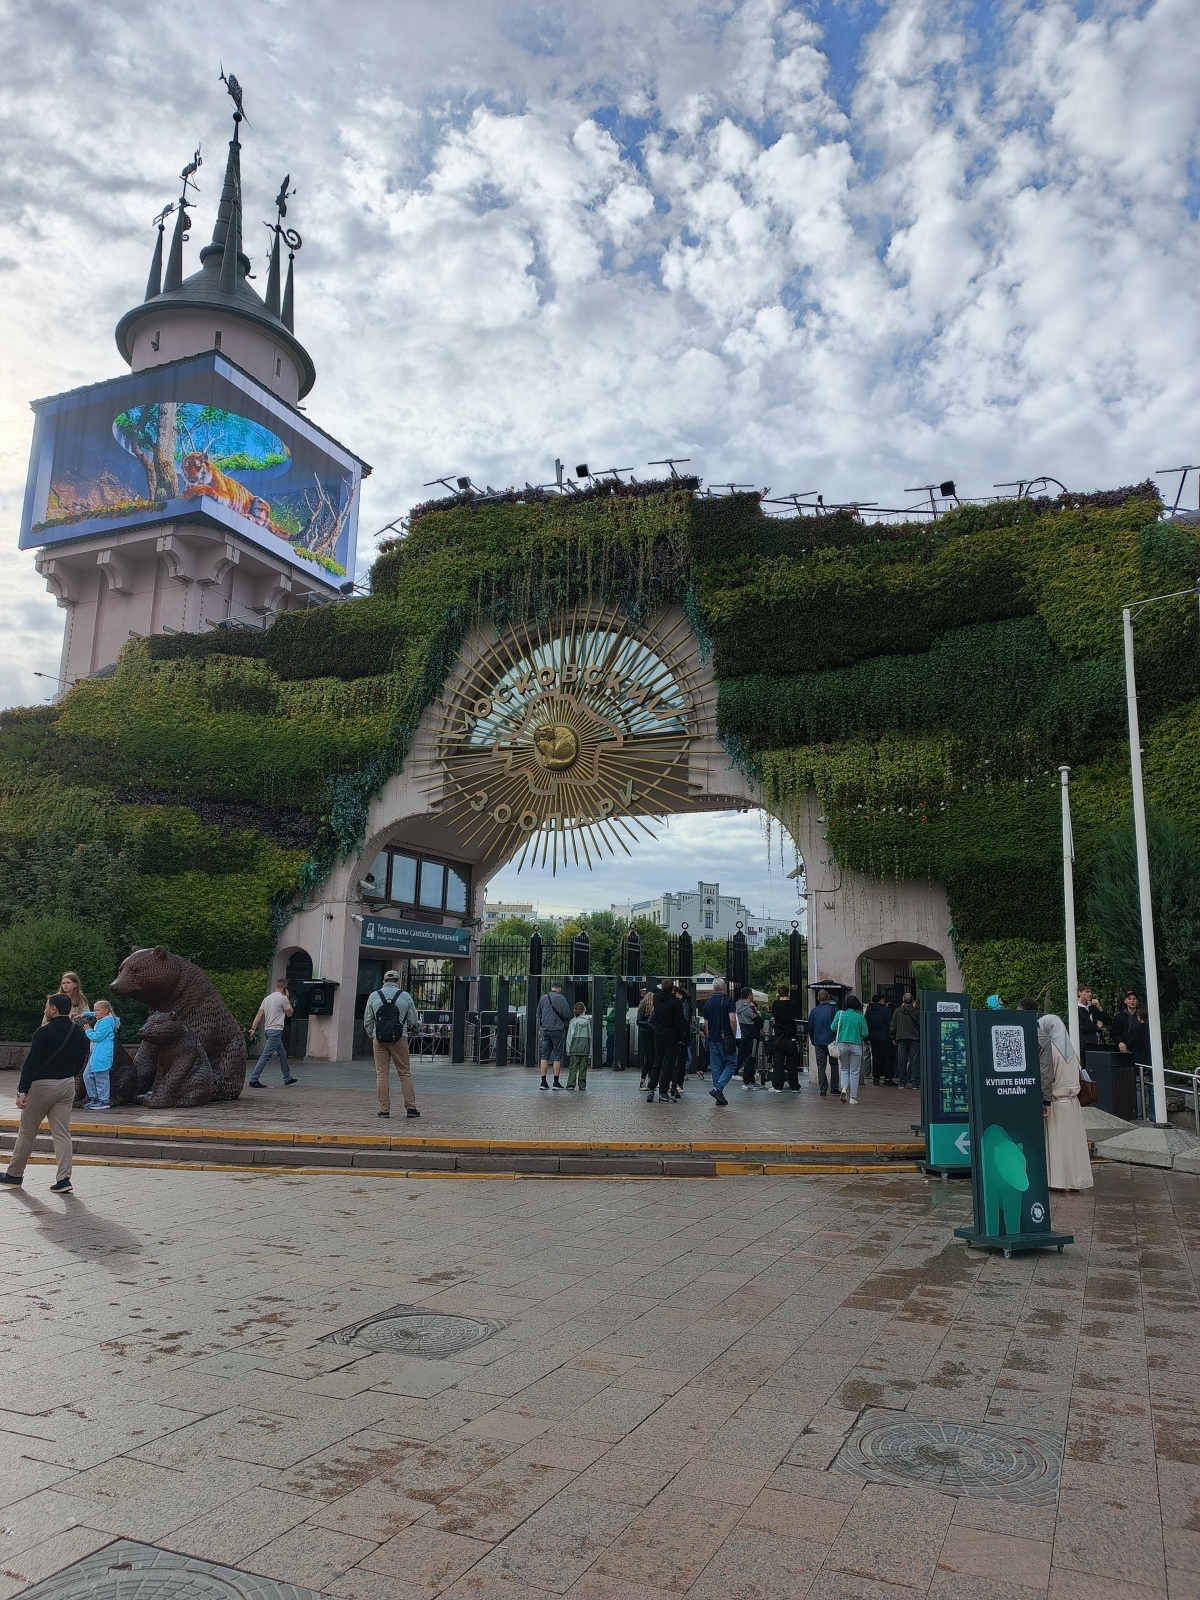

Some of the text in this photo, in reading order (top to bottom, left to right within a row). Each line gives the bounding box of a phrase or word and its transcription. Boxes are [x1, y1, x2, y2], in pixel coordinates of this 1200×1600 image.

[434, 663, 697, 740] МОСКОВСКИЙ
[469, 779, 640, 831] ЗООПАРК
[377, 924, 409, 935] Терминалы
[985, 1078, 1036, 1086] КУПИТЕ БИЛЕТ
[997, 1086, 1026, 1095] ОНЛАЙН
